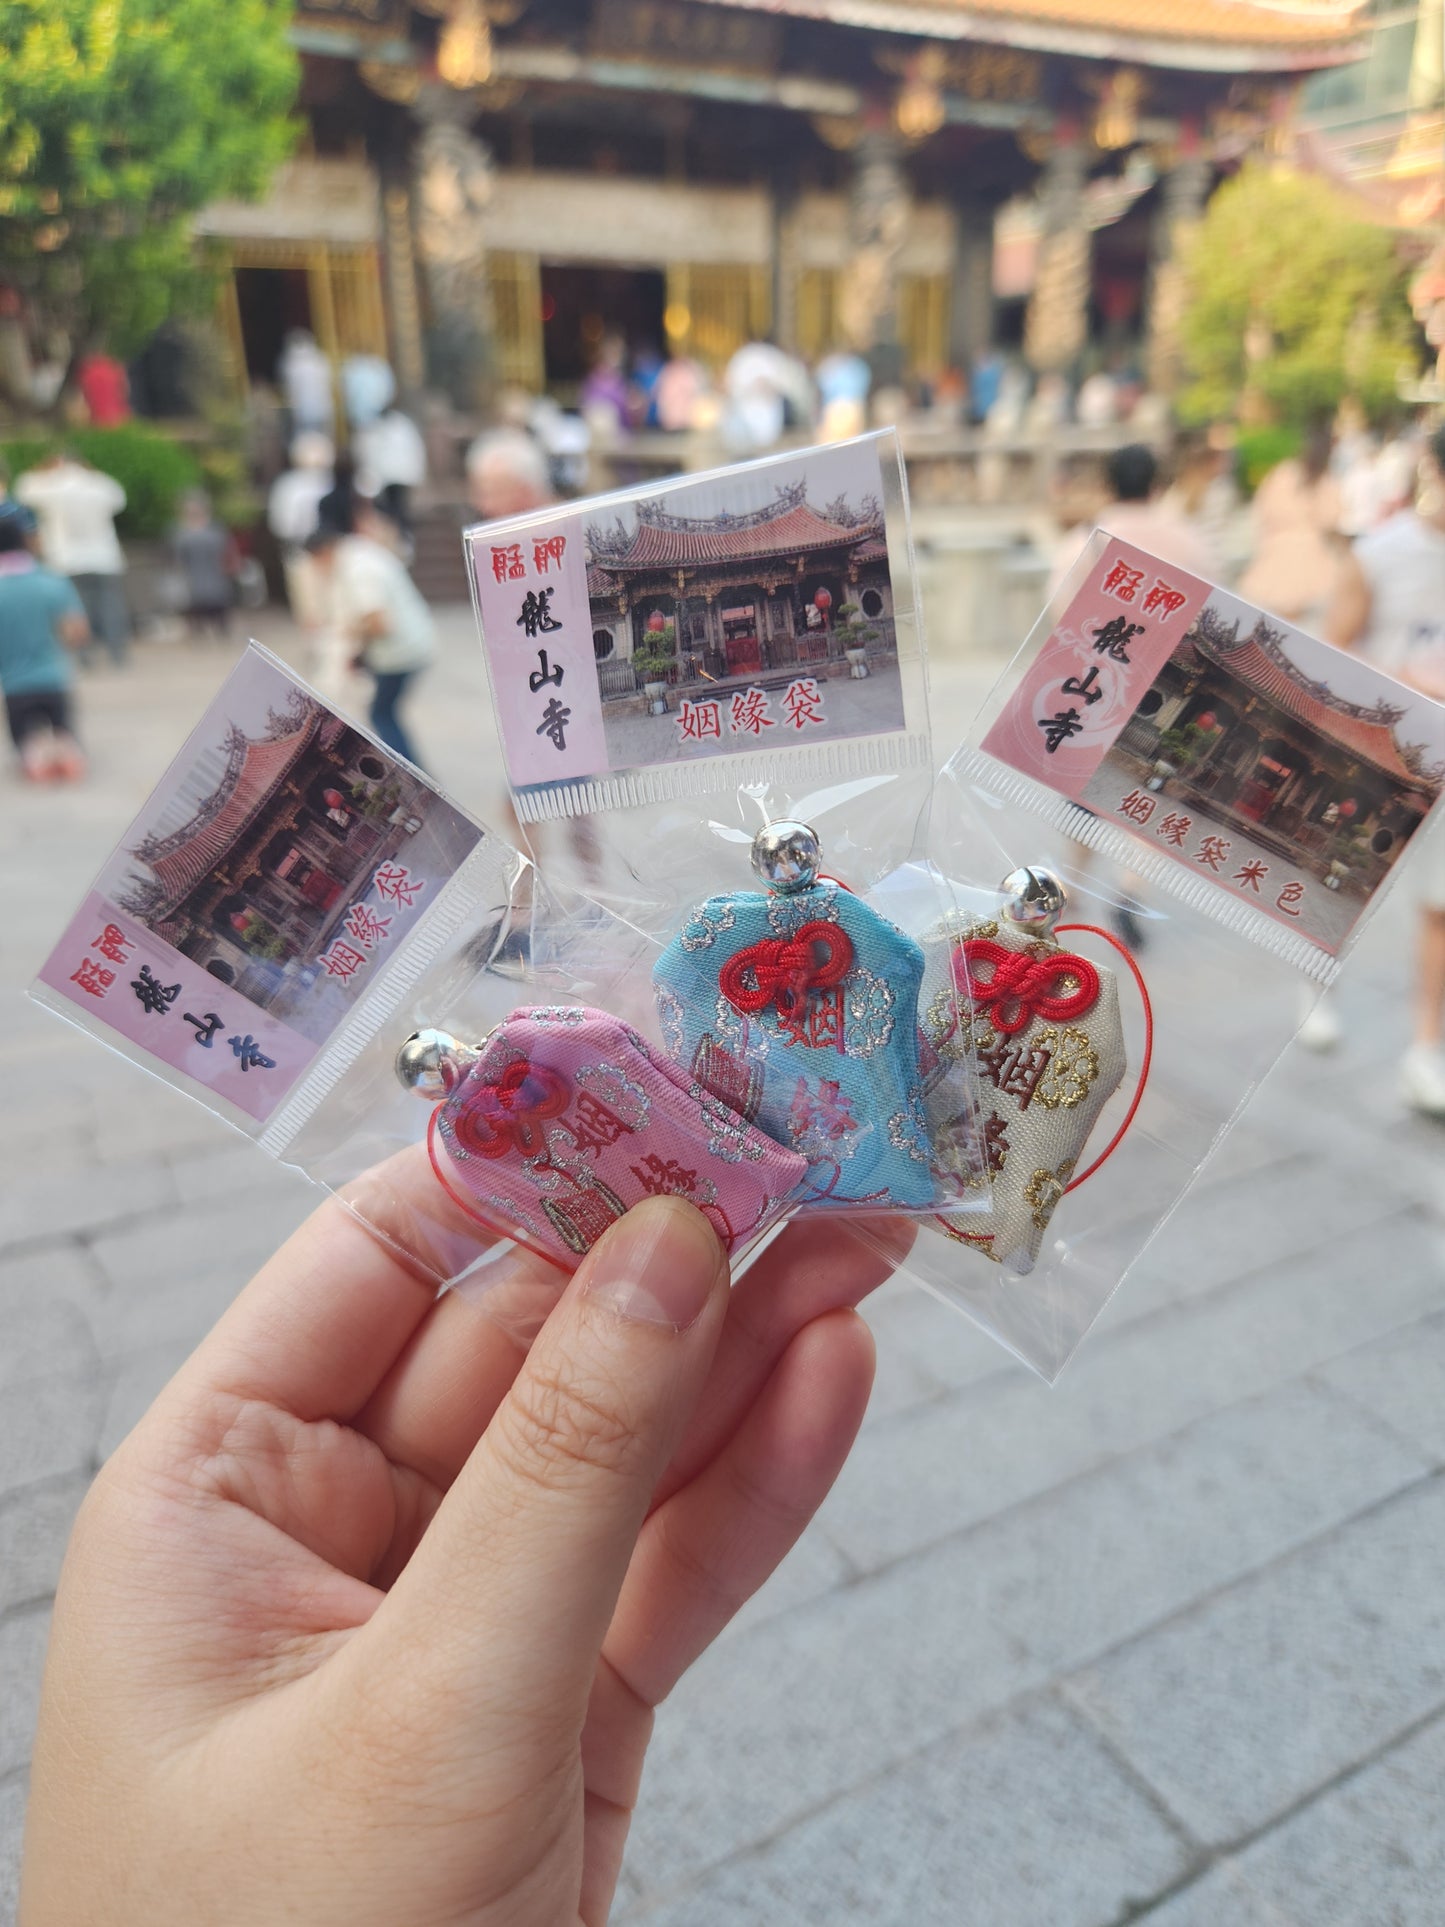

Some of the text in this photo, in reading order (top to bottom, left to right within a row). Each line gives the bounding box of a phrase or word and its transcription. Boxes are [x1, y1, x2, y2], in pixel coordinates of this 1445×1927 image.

[490, 536, 567, 584] 艋舺
[1103, 559, 1186, 620] 艋舺
[516, 586, 571, 752] 龍山寺
[677, 679, 826, 742] 姻緣袋
[1037, 615, 1146, 754] 龍山寺
[1117, 790, 1308, 917] 姻緣袋米色
[70, 923, 136, 998] 艋舺
[320, 860, 425, 983] 姻緣袋
[130, 964, 277, 1072] 龍山寺
